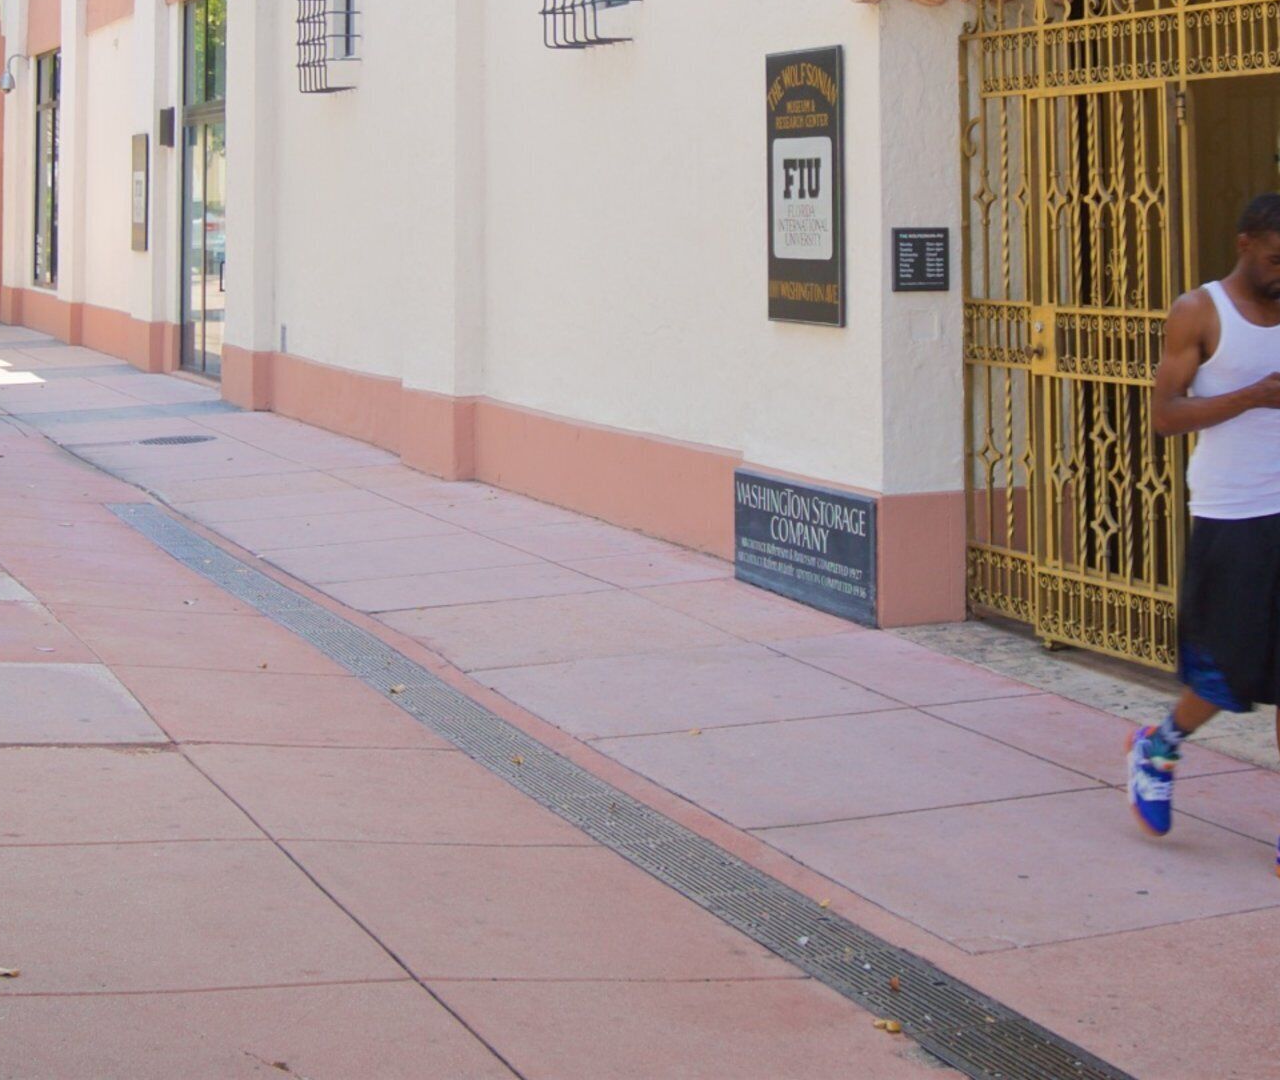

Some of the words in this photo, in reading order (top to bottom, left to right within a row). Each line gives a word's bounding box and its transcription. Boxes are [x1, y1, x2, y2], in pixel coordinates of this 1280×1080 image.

[768, 76, 785, 112] THE
[781, 62, 838, 108] WOLFSONIAN
[783, 157, 821, 200] FIU
[787, 204, 816, 218] FLORIDA
[736, 480, 810, 521] WASHINGTON
[812, 496, 867, 537] STORAGE
[770, 515, 830, 554] COMPANY
